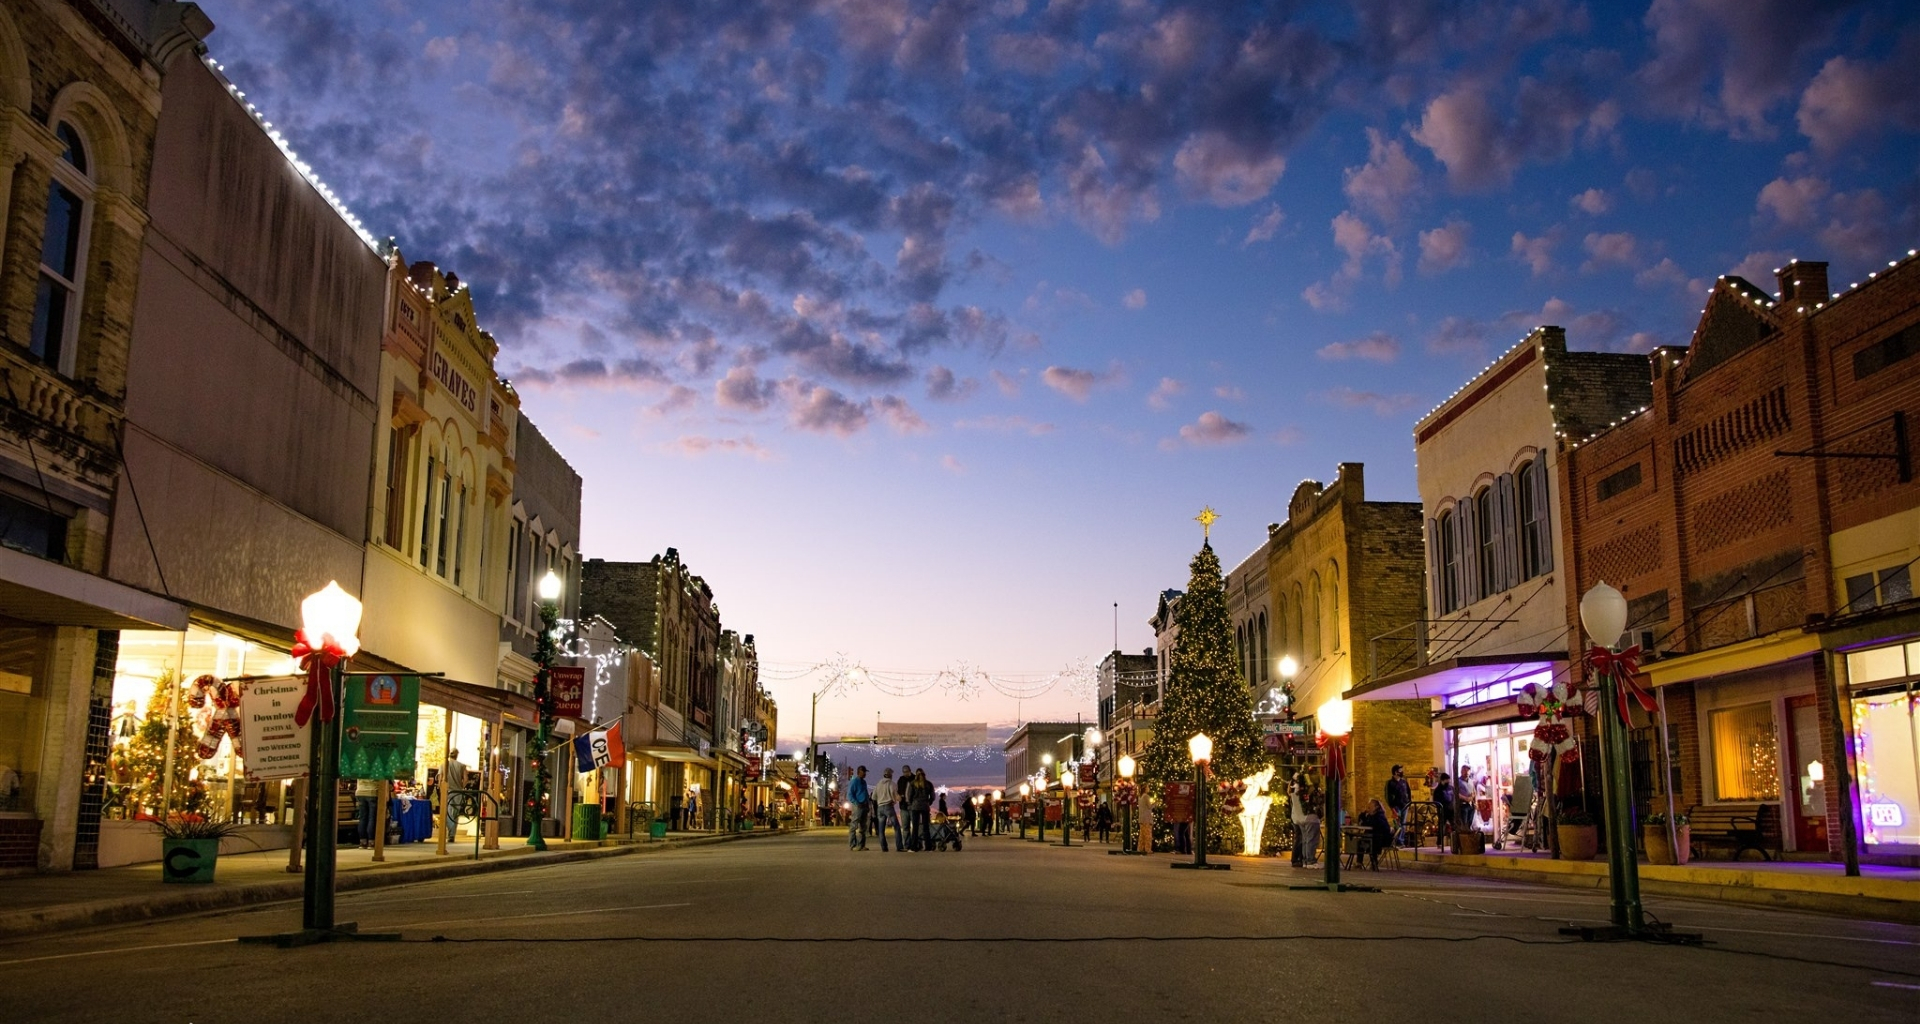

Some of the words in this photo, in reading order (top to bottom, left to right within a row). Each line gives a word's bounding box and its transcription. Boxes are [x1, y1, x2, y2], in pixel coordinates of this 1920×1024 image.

[433, 351, 476, 412] GRAVES
[553, 672, 582, 680] Unwrap
[254, 685, 298, 696] Christmas
[271, 699, 281, 707] in
[253, 711, 295, 722] Downtow
[263, 724, 293, 732] FESTIVAL
[164, 846, 202, 878] C
